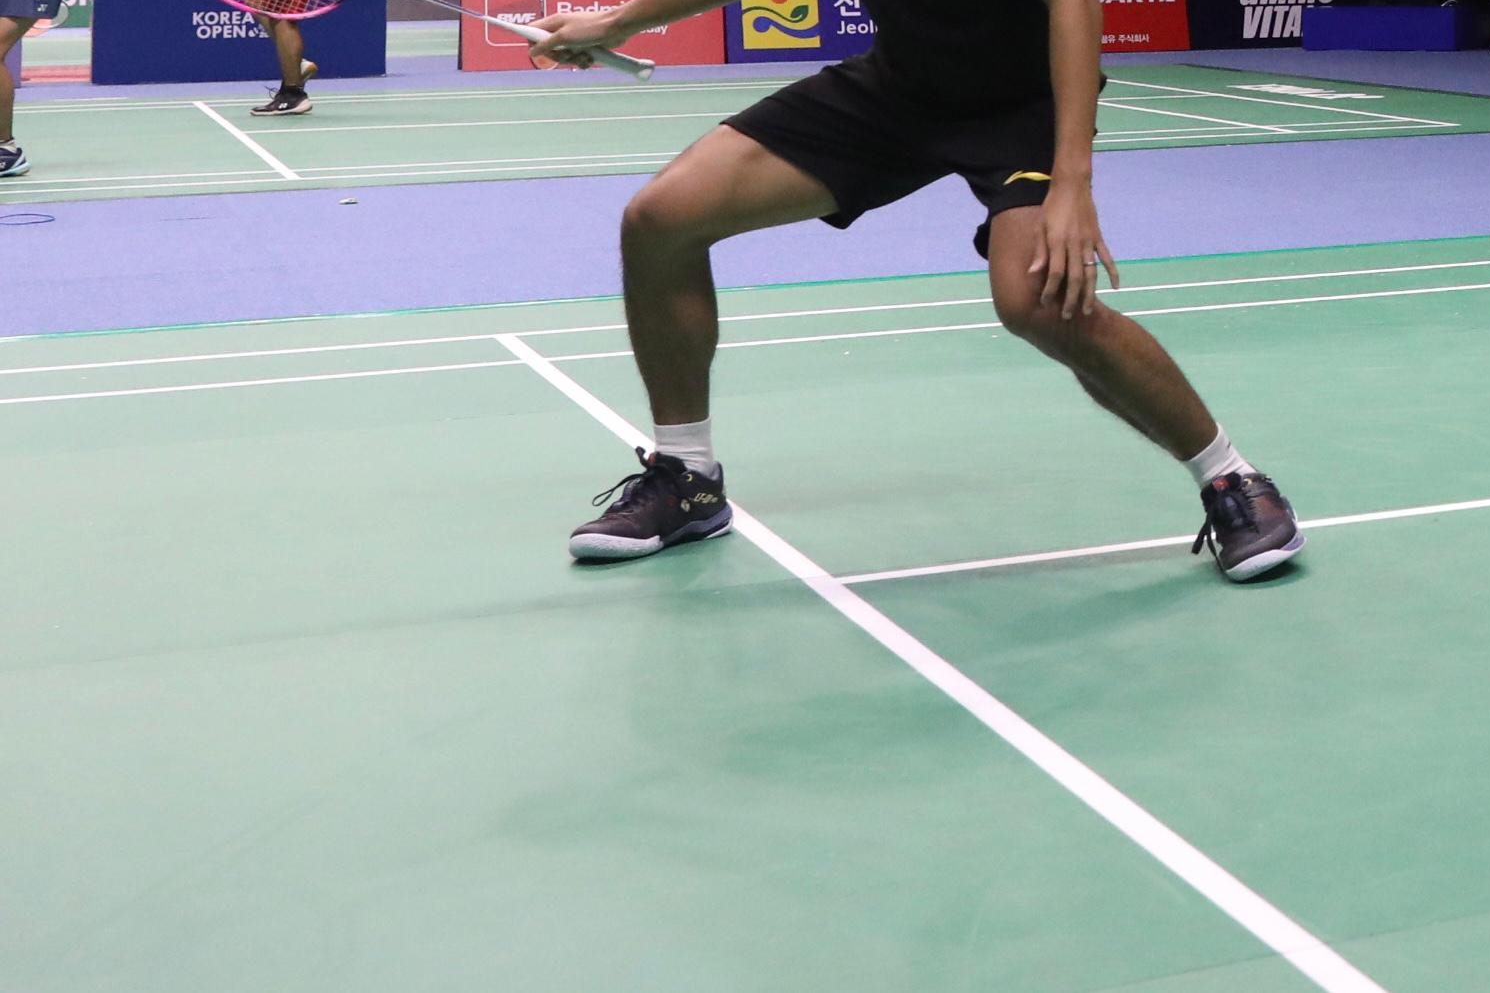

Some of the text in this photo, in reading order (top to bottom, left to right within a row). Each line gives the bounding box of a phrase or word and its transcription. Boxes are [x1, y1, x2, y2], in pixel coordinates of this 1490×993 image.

[192, 11, 255, 25] KOREA
[1242, 5, 1306, 39] VITA
[196, 25, 247, 39] OPEN
